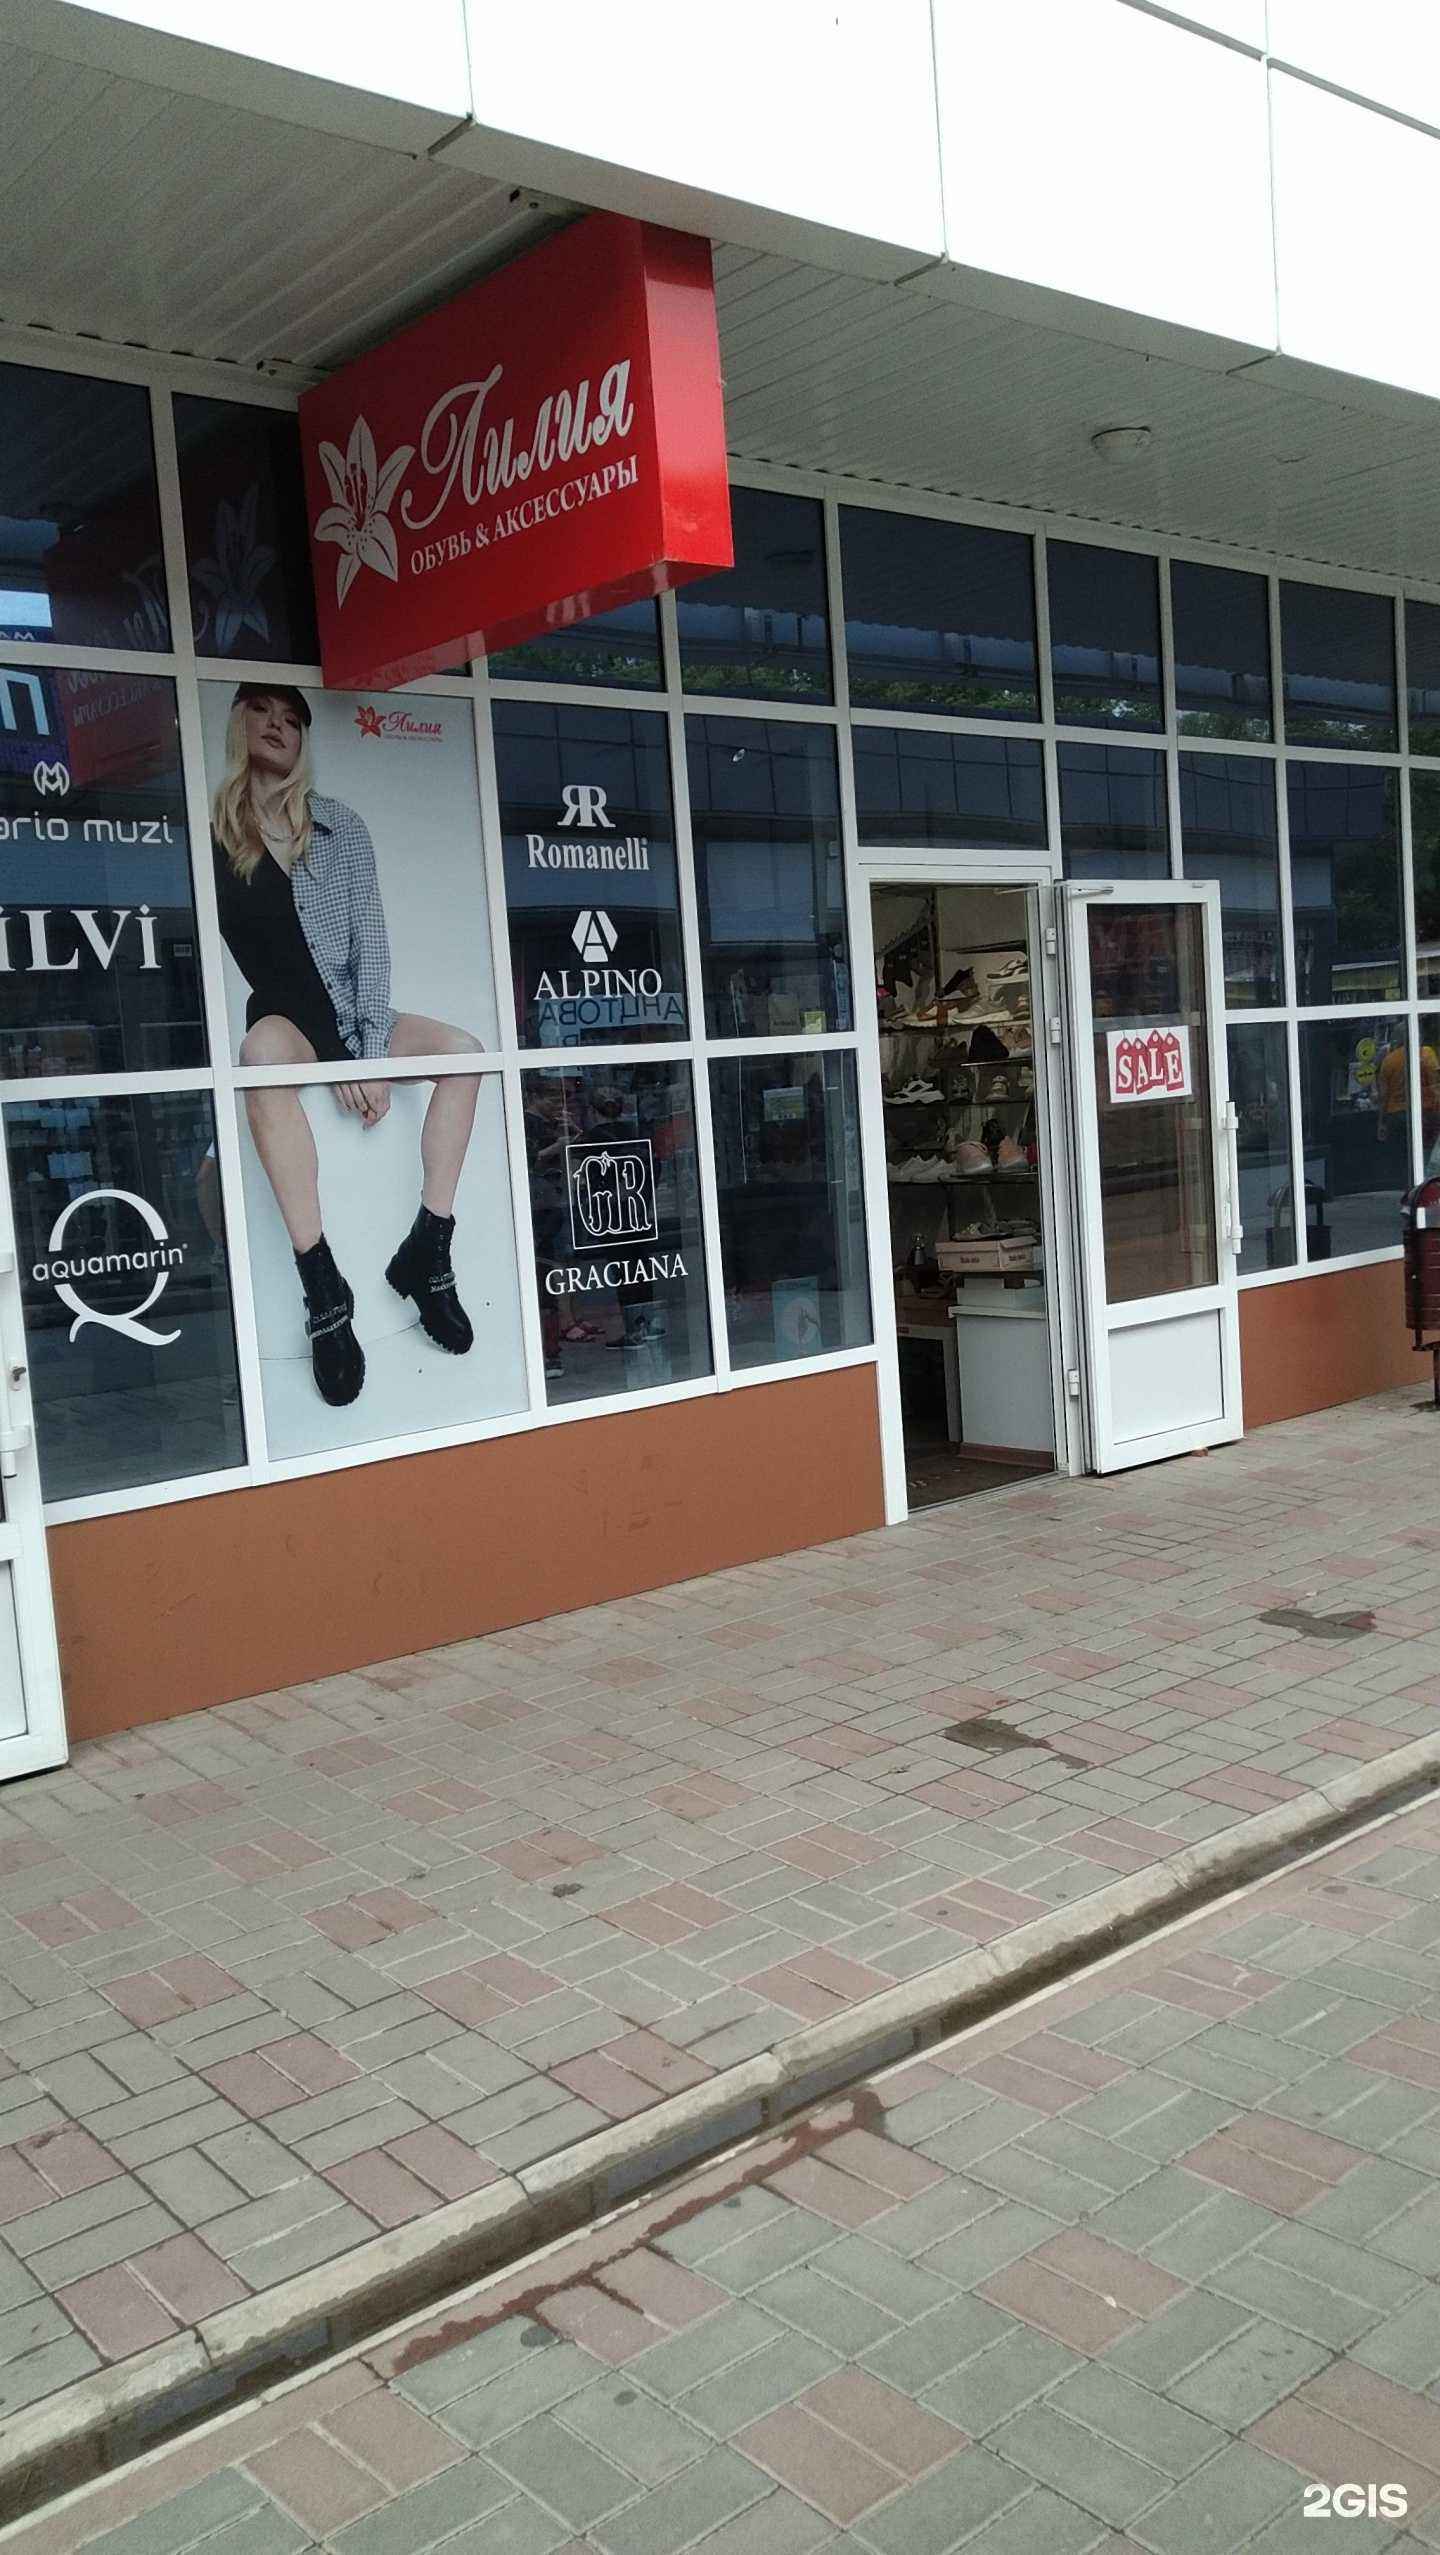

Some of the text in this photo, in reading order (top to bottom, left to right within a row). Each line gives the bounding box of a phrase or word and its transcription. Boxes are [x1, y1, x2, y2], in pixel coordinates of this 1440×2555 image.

[400, 360, 634, 530] Лилия
[411, 455, 639, 575] ОБУВЬ & АКСЕССУАРЫ
[83, 815, 174, 843] muzi
[526, 834, 650, 870] Romanelli
[533, 968, 663, 1001] ALPINO
[1117, 1047, 1183, 1089] SALE
[545, 1253, 688, 1295] GRACIANA
